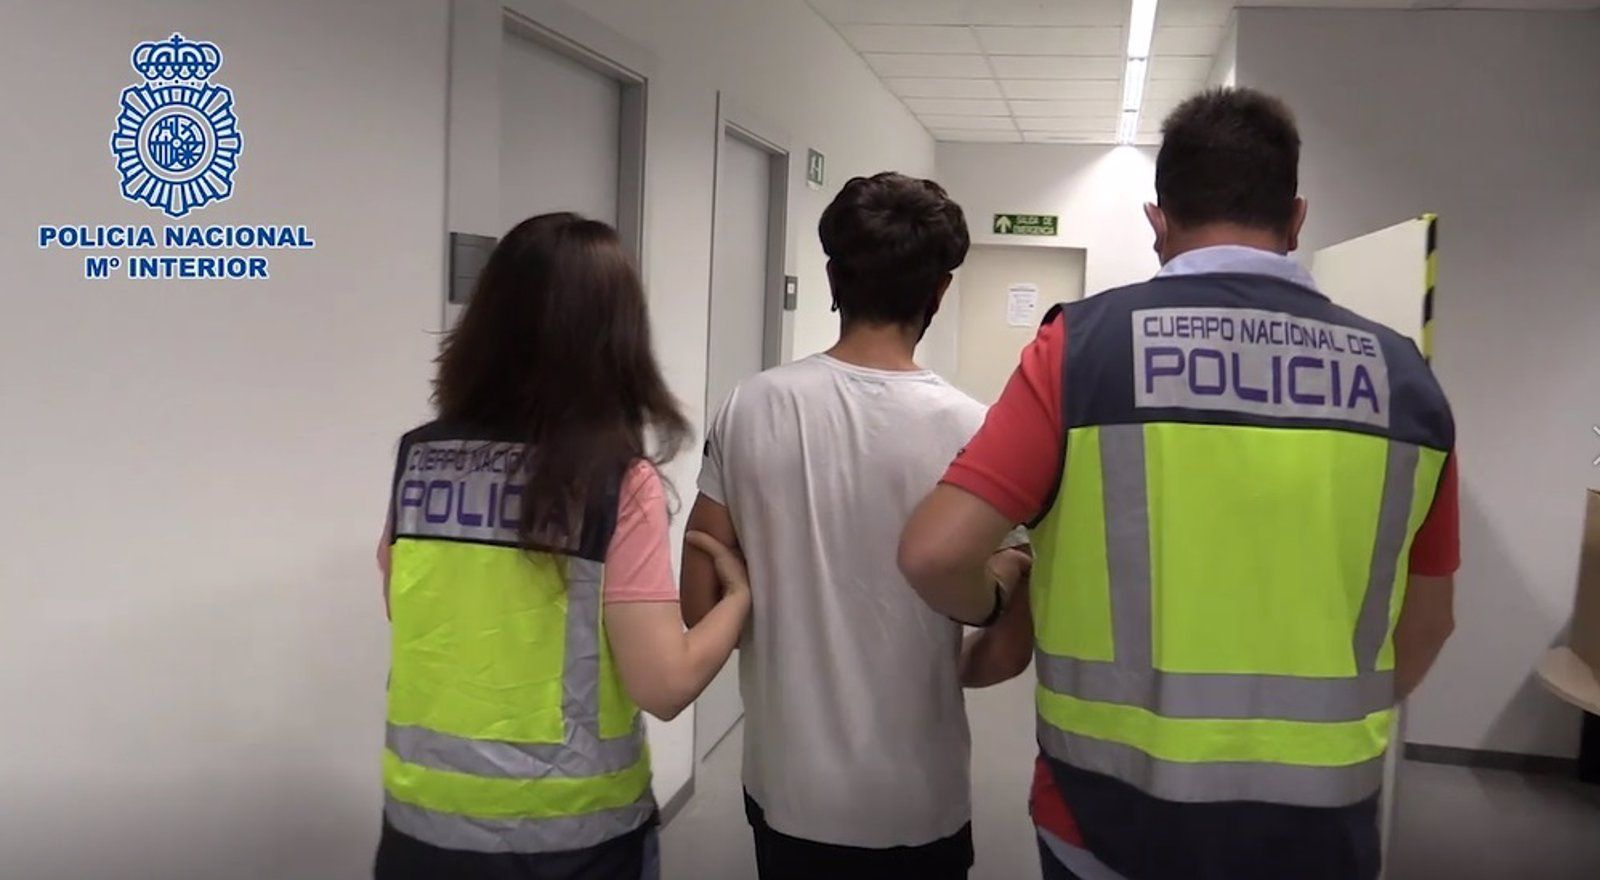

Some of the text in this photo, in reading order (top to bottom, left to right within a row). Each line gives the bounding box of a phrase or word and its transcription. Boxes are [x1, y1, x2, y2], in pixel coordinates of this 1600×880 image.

[1144, 316, 1377, 357] CUERPO NACIONAL DE
[1144, 346, 1380, 413] POLICIA
[401, 479, 569, 535] POLICA
